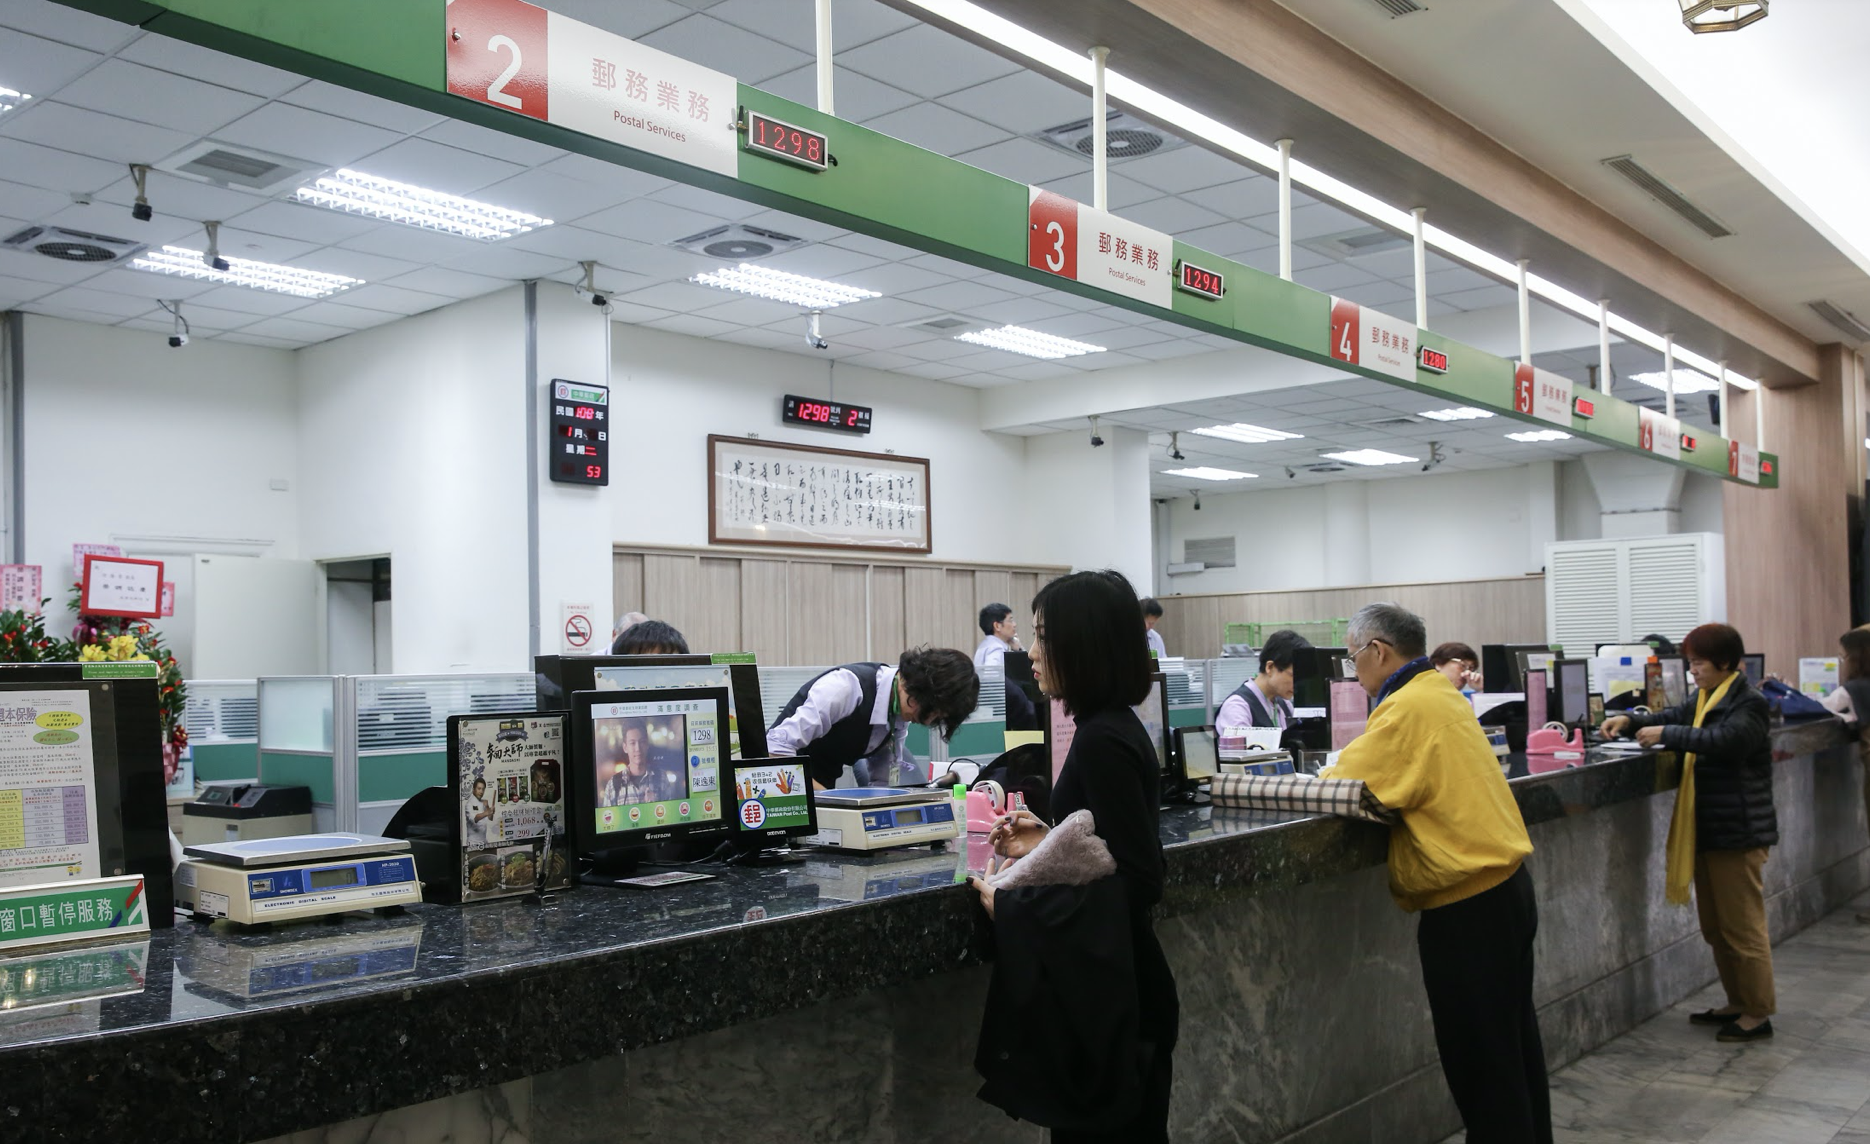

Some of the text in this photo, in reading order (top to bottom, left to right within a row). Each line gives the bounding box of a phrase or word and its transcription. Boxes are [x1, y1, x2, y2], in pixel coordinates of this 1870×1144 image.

[486, 34, 523, 110] 2
[592, 57, 710, 123] 郵務業務
[613, 110, 686, 143] Postal Services
[757, 120, 820, 161] 1298
[1045, 221, 1065, 272] 3
[1098, 232, 1159, 271] 郵務業務
[1108, 267, 1146, 287] Postal Services
[1185, 267, 1219, 294] 1294
[1339, 322, 1352, 362] 4
[1423, 350, 1447, 369] 1280
[1521, 380, 1530, 413] 5
[798, 403, 830, 422] 1298
[847, 410, 858, 426] 2
[1643, 423, 1651, 450] 6
[586, 465, 601, 478] 53
[693, 729, 711, 741] 1298
[0, 897, 114, 933] 窗口暫停服務
[264, 900, 295, 908] ELECTRONIC
